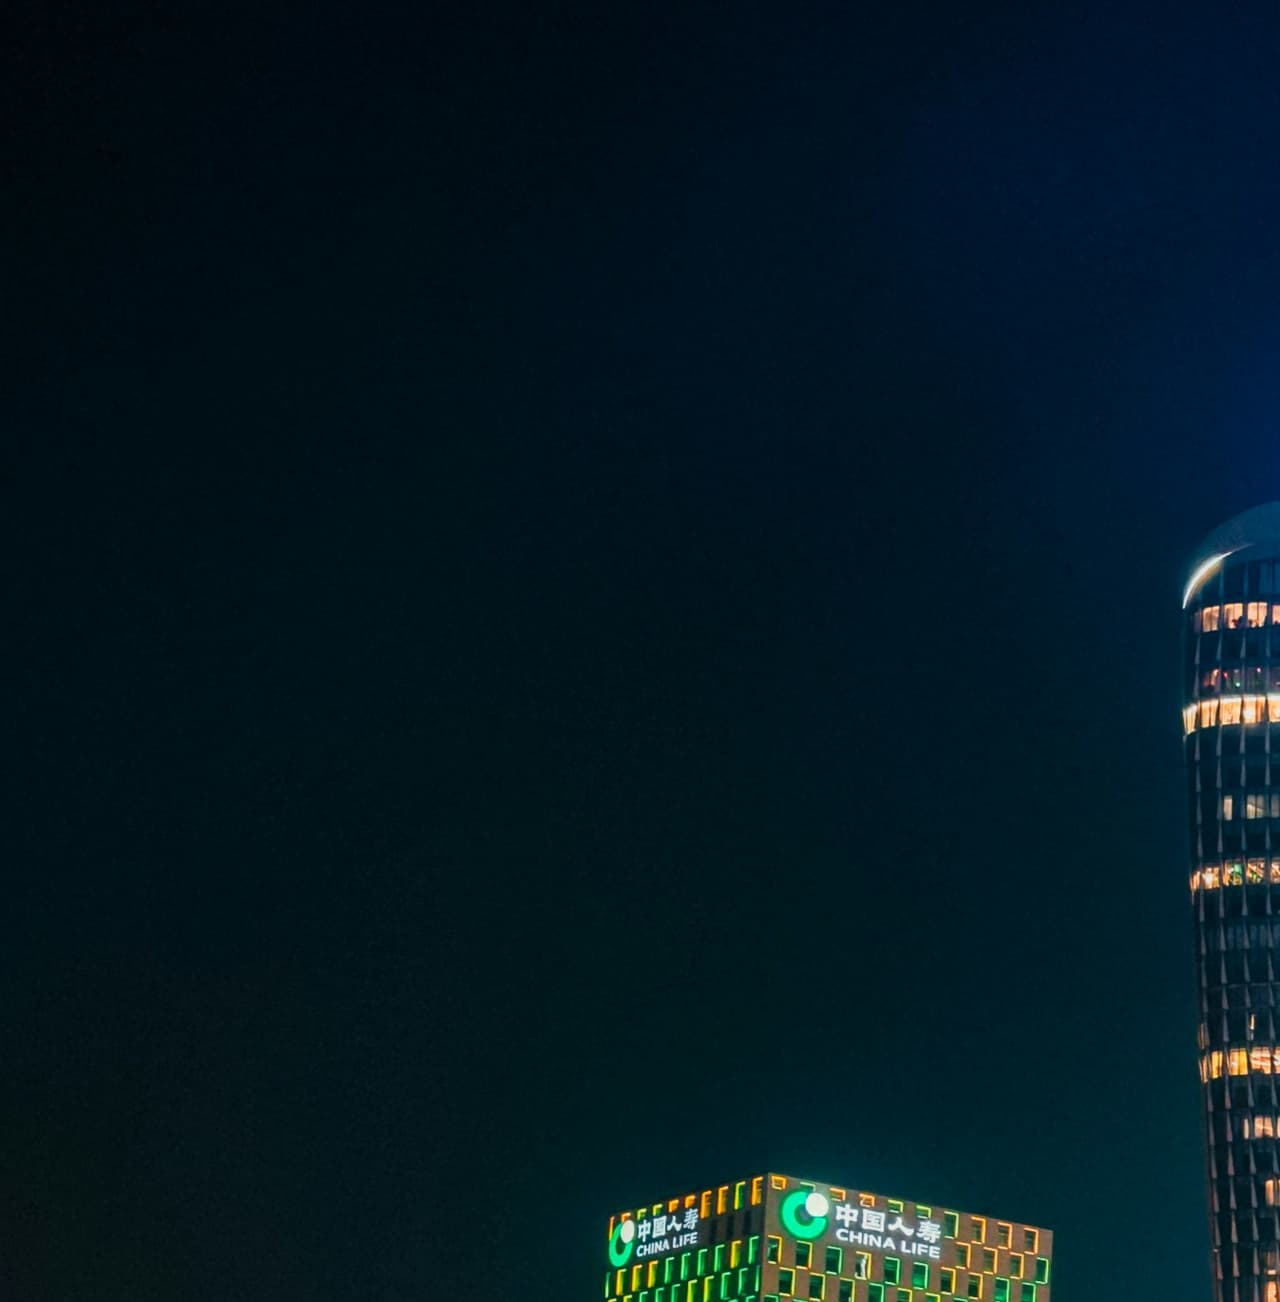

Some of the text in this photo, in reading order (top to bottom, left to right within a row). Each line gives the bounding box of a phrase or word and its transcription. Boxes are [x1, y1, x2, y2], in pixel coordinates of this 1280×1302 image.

[637, 1208, 699, 1243] 中国人寿
[835, 1203, 942, 1244] 中国人寿
[636, 1231, 699, 1258] CHINA LIFE
[835, 1228, 941, 1259] CHINA LIFE
